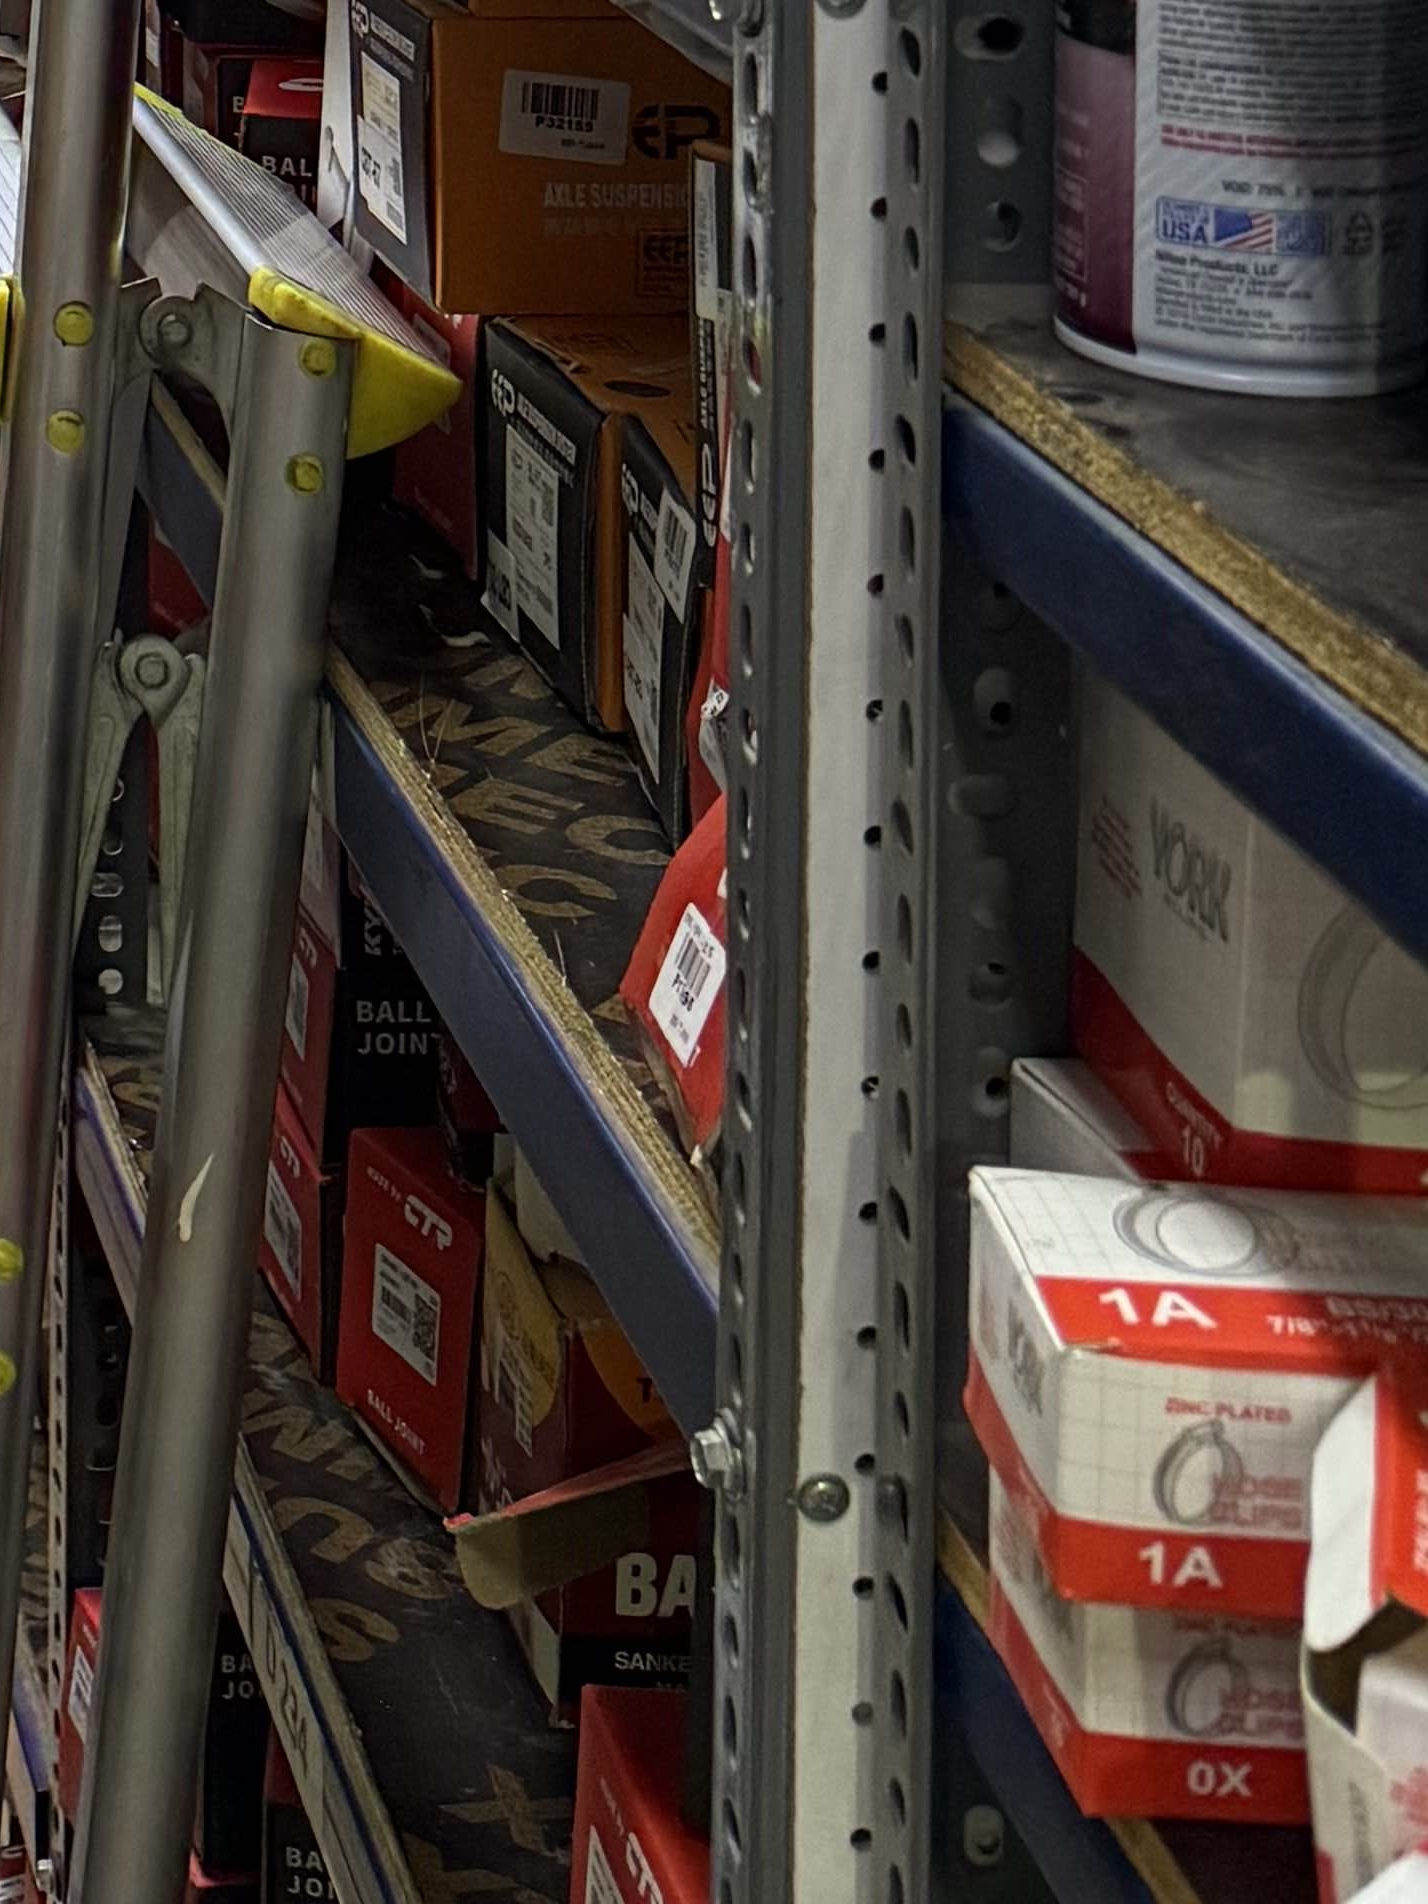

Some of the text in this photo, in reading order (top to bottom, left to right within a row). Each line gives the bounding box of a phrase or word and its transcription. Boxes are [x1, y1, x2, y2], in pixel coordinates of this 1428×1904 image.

[1162, 221, 1209, 244] USA
[356, 1001, 432, 1023] BALL
[356, 1032, 446, 1055] JOINT
[404, 1194, 453, 1250] CTR
[1098, 1288, 1217, 1331] 1A
[1139, 1542, 1223, 1588] 1A
[614, 1651, 691, 1672] SANKE
